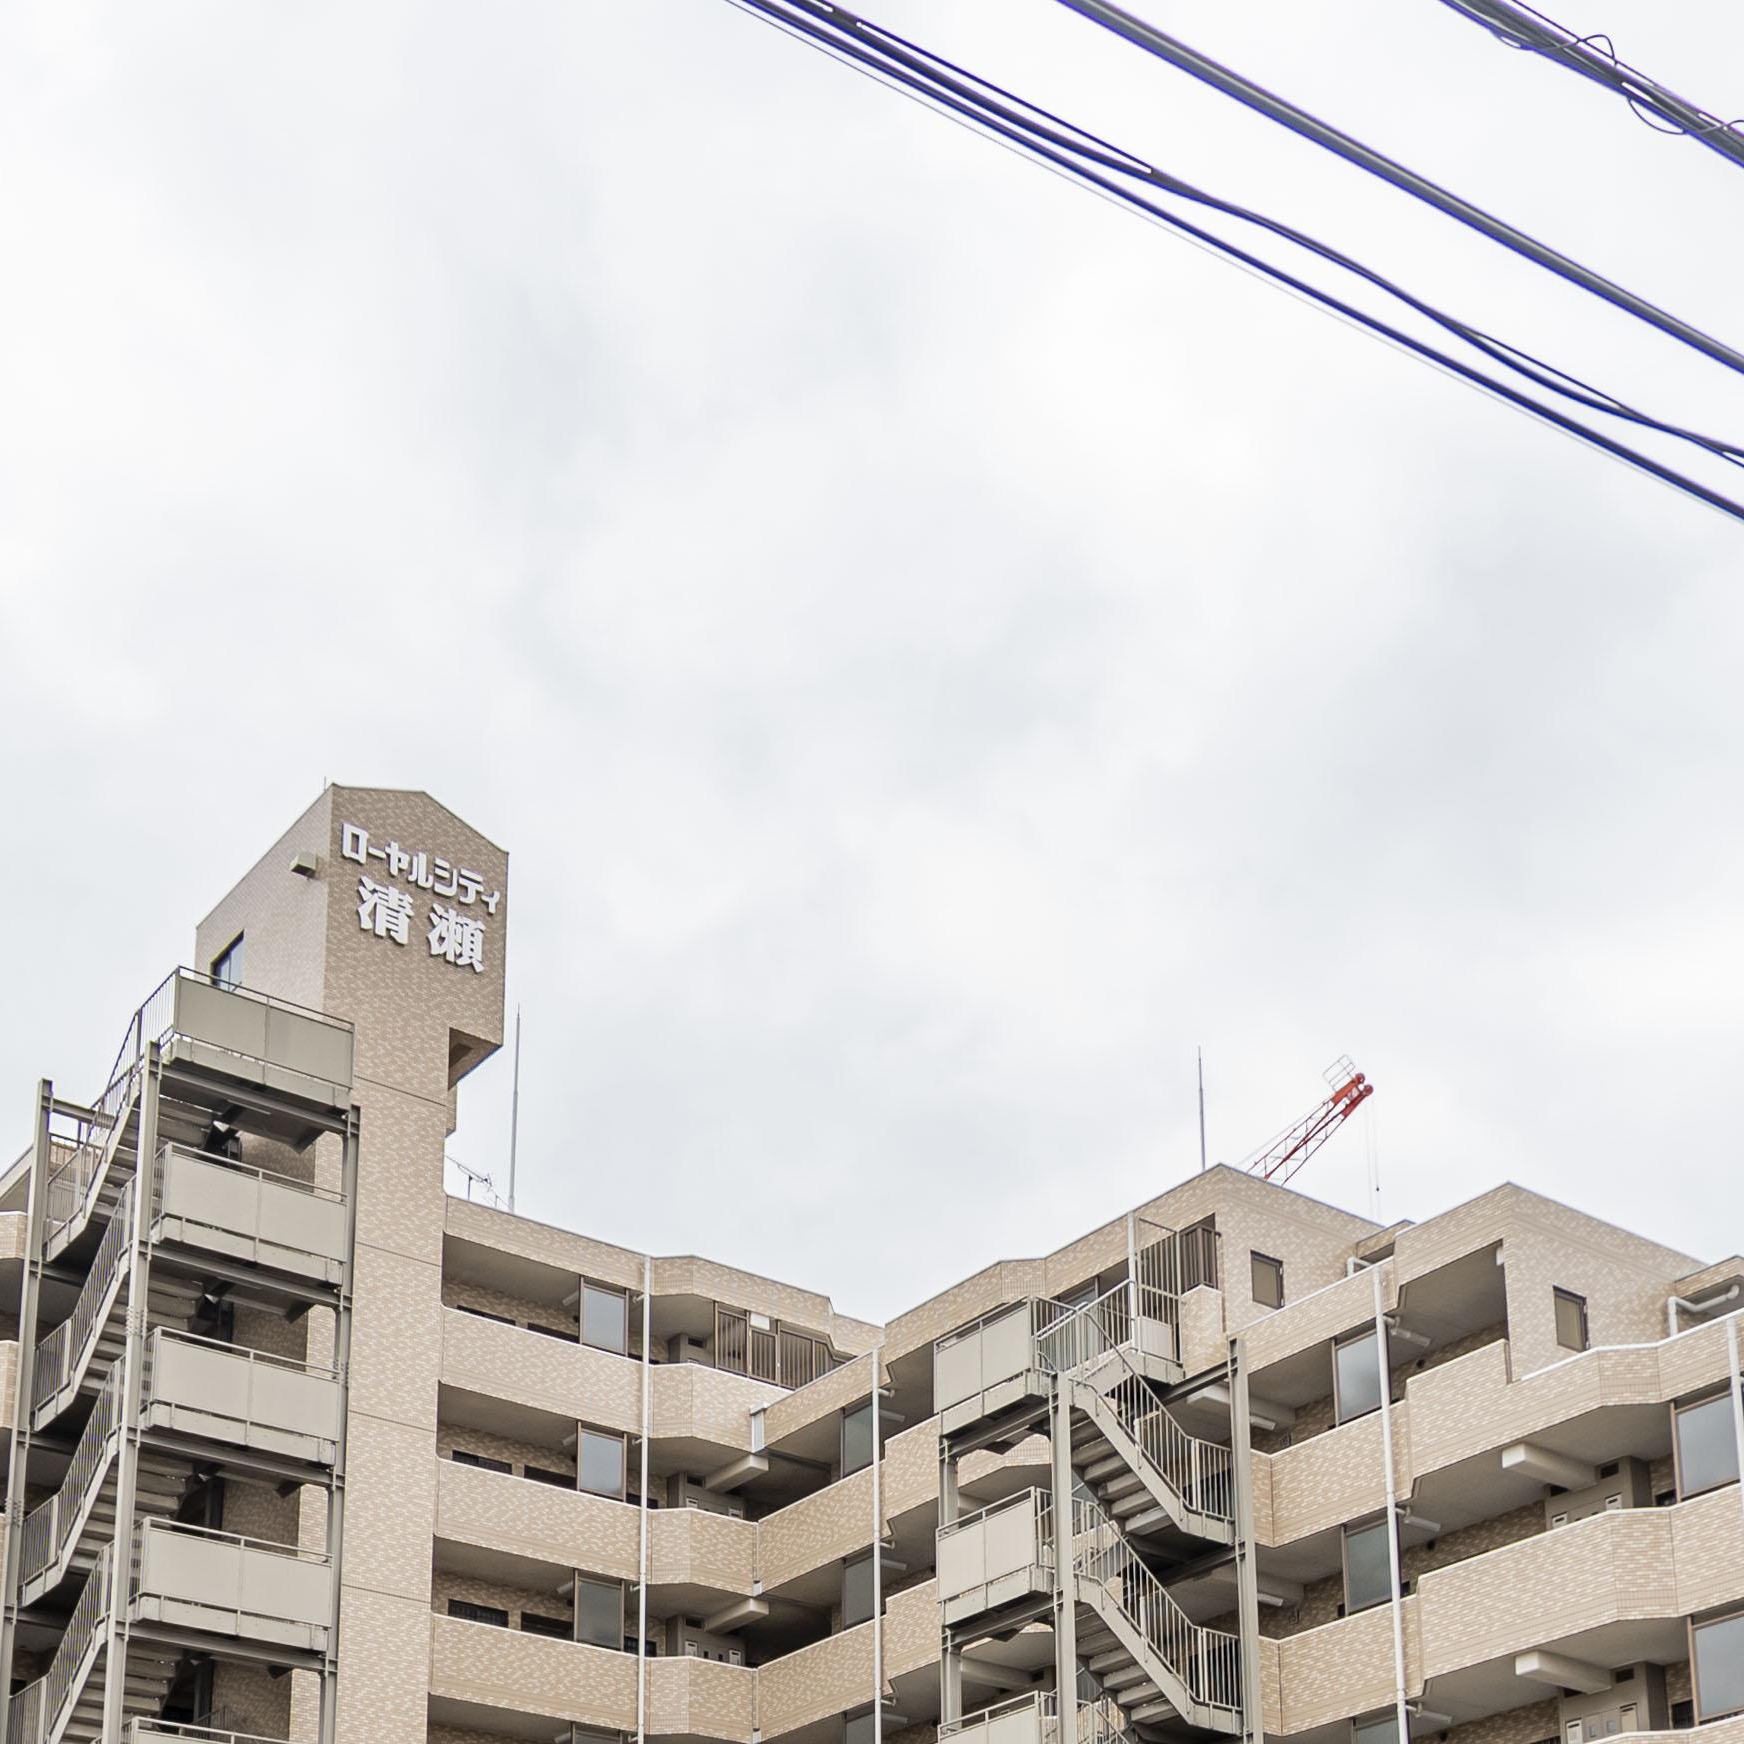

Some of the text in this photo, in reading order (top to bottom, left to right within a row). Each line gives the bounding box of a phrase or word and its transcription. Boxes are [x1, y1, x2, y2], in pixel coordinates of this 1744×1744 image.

[341, 821, 501, 915] ローヤルシティ
[356, 875, 486, 974] 清瀬
